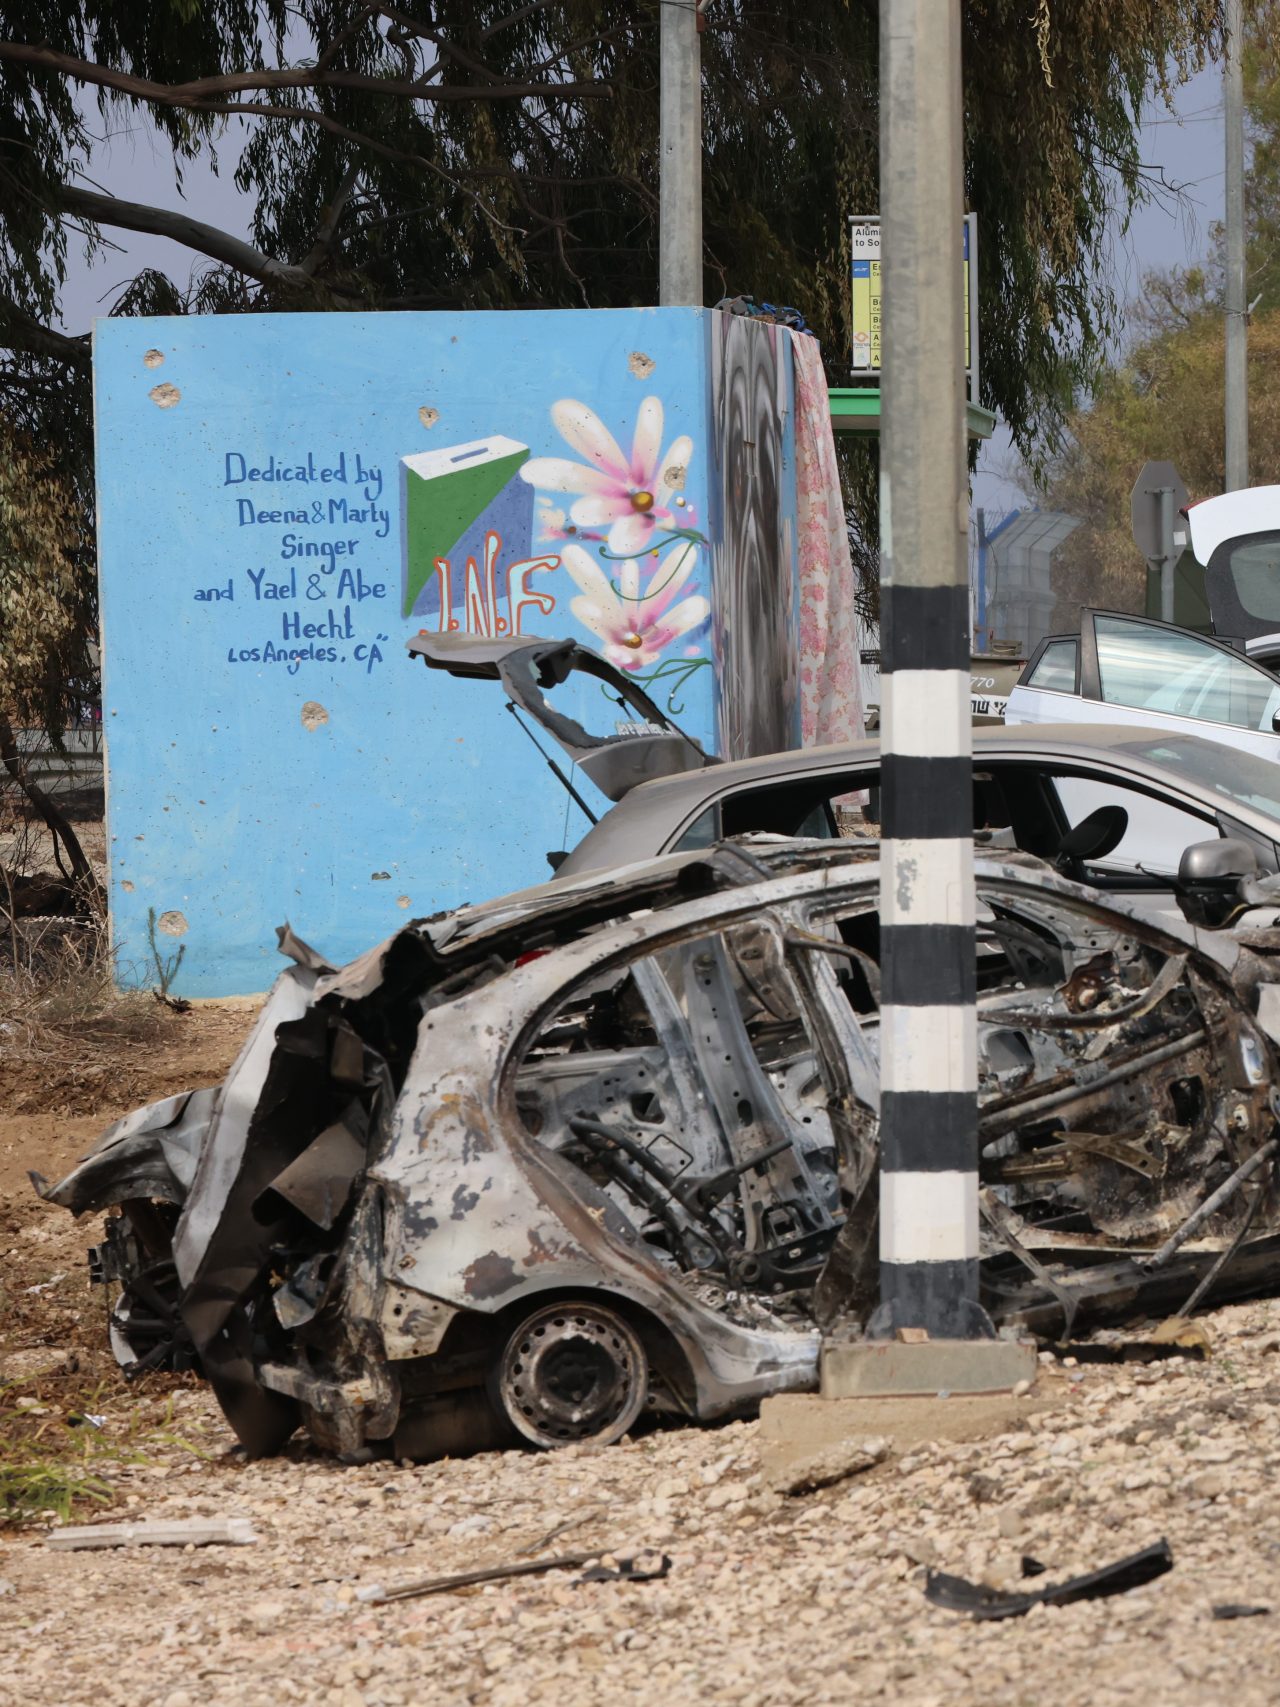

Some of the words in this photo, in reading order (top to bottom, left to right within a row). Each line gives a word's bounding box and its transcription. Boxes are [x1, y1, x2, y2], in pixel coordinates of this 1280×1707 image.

[855, 239, 865, 247] to
[224, 452, 347, 486] Dedicated
[355, 454, 383, 501] by
[280, 533, 359, 574] Singer
[193, 579, 234, 601] and
[246, 567, 297, 600] Yael
[305, 573, 327, 600] &
[337, 567, 387, 602] Abe
[282, 605, 356, 640] Hecht
